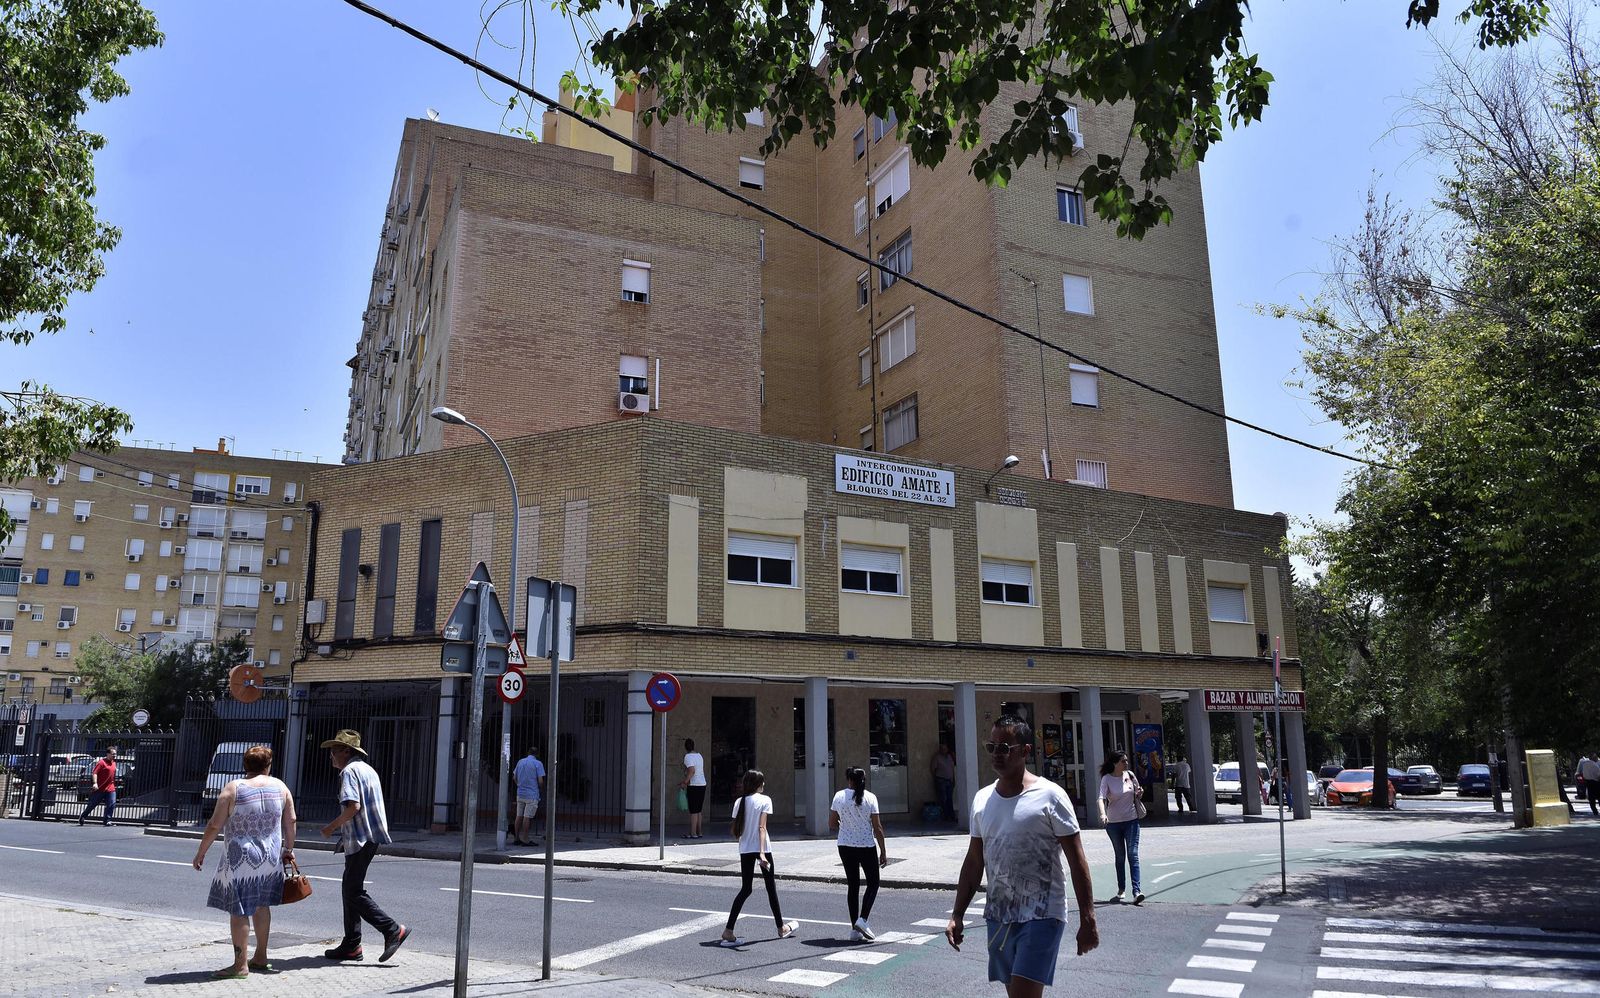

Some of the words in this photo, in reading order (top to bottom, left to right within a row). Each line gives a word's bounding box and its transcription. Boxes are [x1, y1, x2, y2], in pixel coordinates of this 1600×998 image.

[857, 460, 937, 478] INTERCOMUNIDAD
[841, 466, 894, 487] EDIFICIO
[901, 476, 940, 494] AMATE
[946, 482, 950, 495] I
[846, 484, 889, 496] BLOQUES
[892, 489, 909, 499] DEL
[937, 496, 947, 504] 32
[504, 679, 520, 691] 30
[1210, 691, 1236, 704] BAZAR
[1239, 692, 1244, 704] Y
[1246, 692, 1300, 705] ALIMENACION
